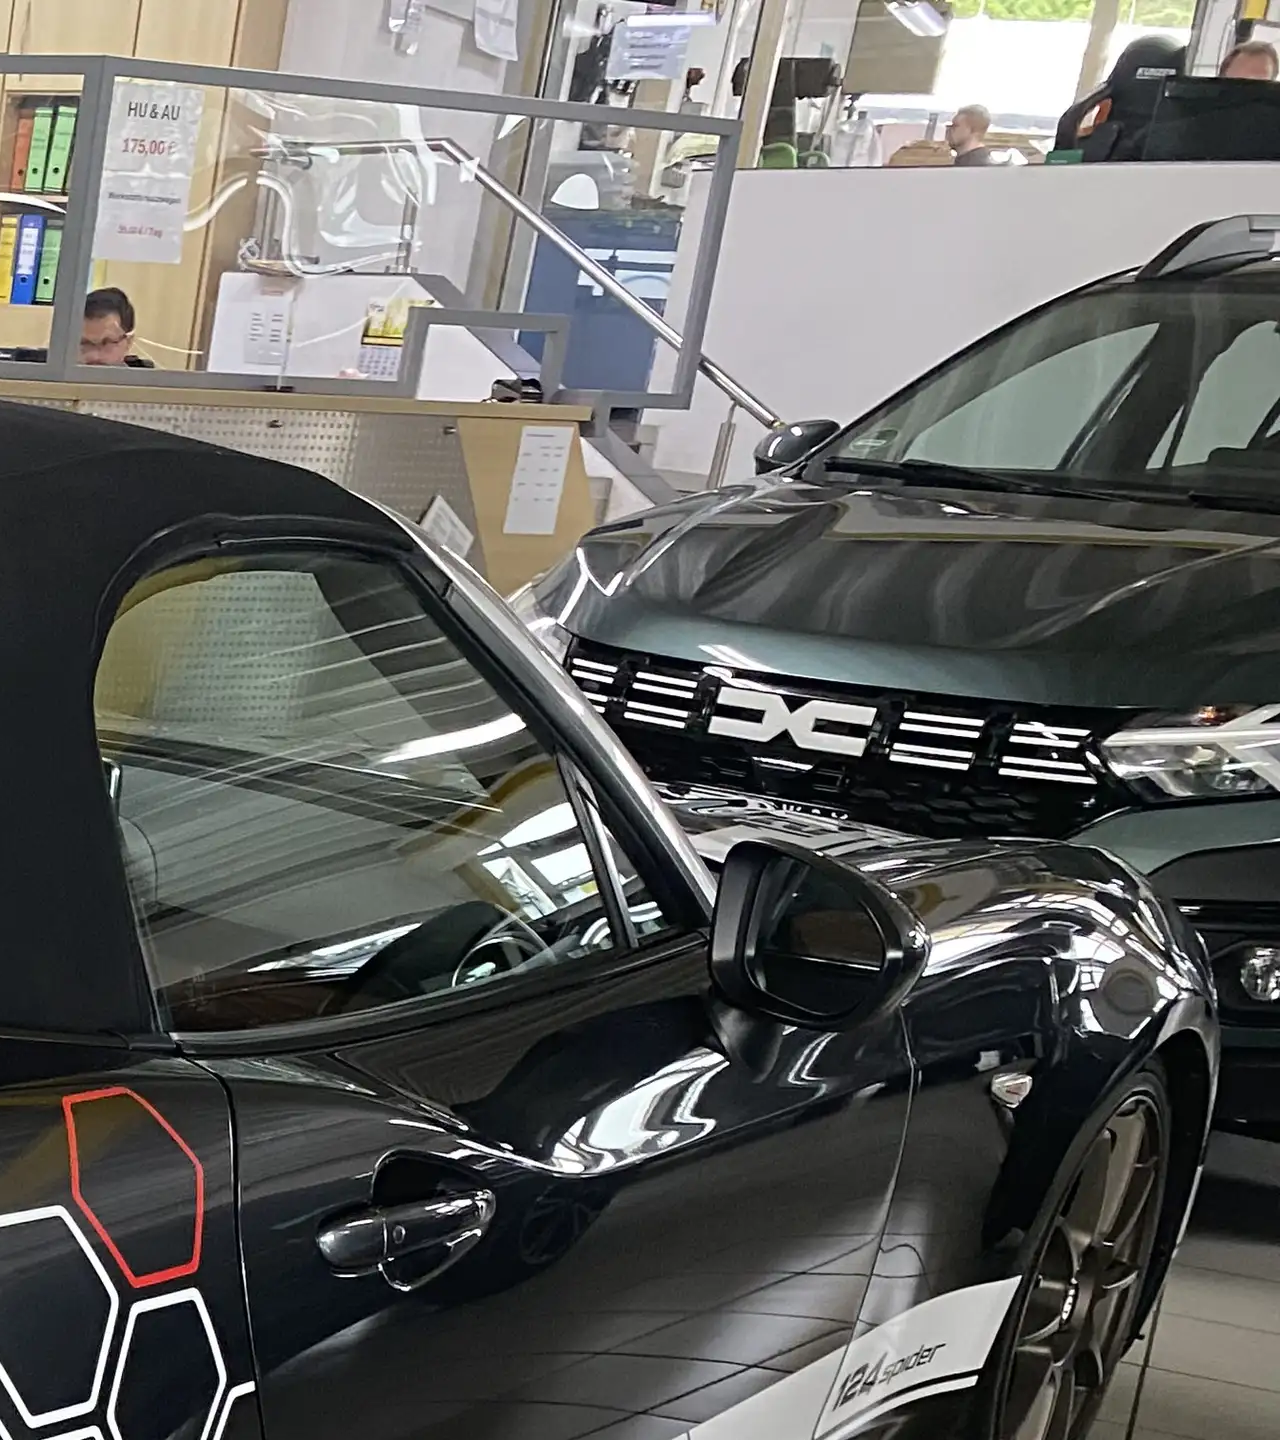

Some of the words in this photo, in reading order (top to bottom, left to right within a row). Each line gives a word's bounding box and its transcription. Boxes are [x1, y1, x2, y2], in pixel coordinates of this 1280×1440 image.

[127, 101, 148, 118] HU
[149, 104, 159, 119] &
[161, 105, 181, 121] AU
[122, 137, 165, 156] 175,00
[832, 1351, 888, 1412] 124
[878, 1343, 947, 1385] spider
